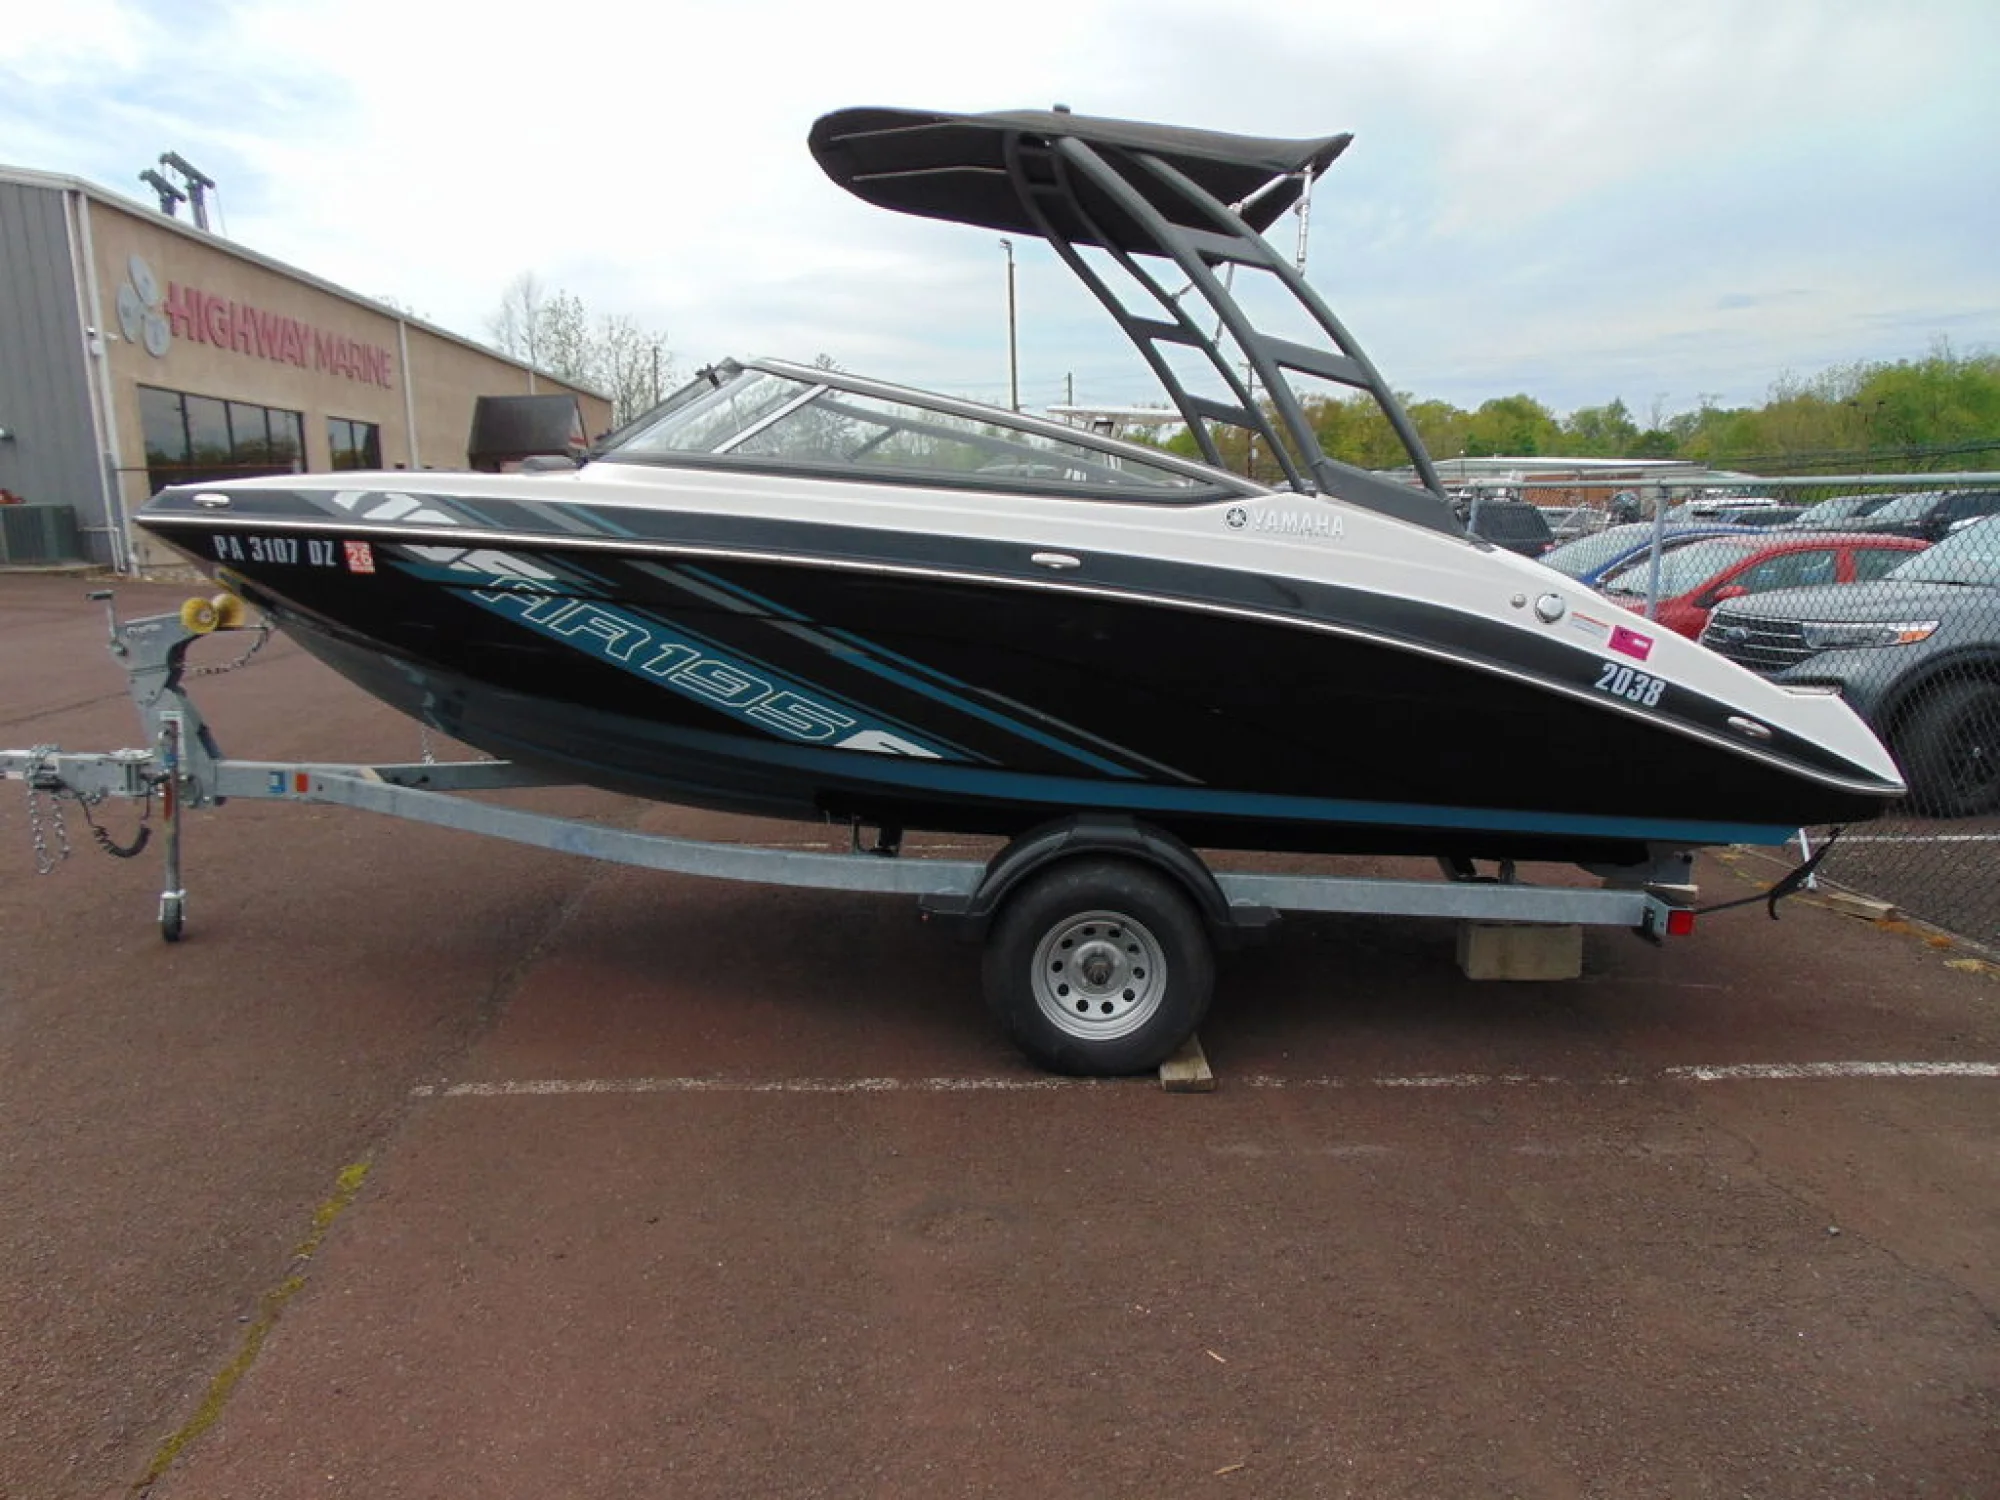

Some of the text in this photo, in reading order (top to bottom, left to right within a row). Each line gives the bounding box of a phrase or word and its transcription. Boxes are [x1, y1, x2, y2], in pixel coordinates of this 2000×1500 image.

[164, 280, 392, 389] HIGHWAY MARINE
[1252, 507, 1345, 540] YAMAHA
[213, 534, 245, 560] PA
[248, 536, 298, 564] 3107
[1595, 663, 1666, 706] 2038
